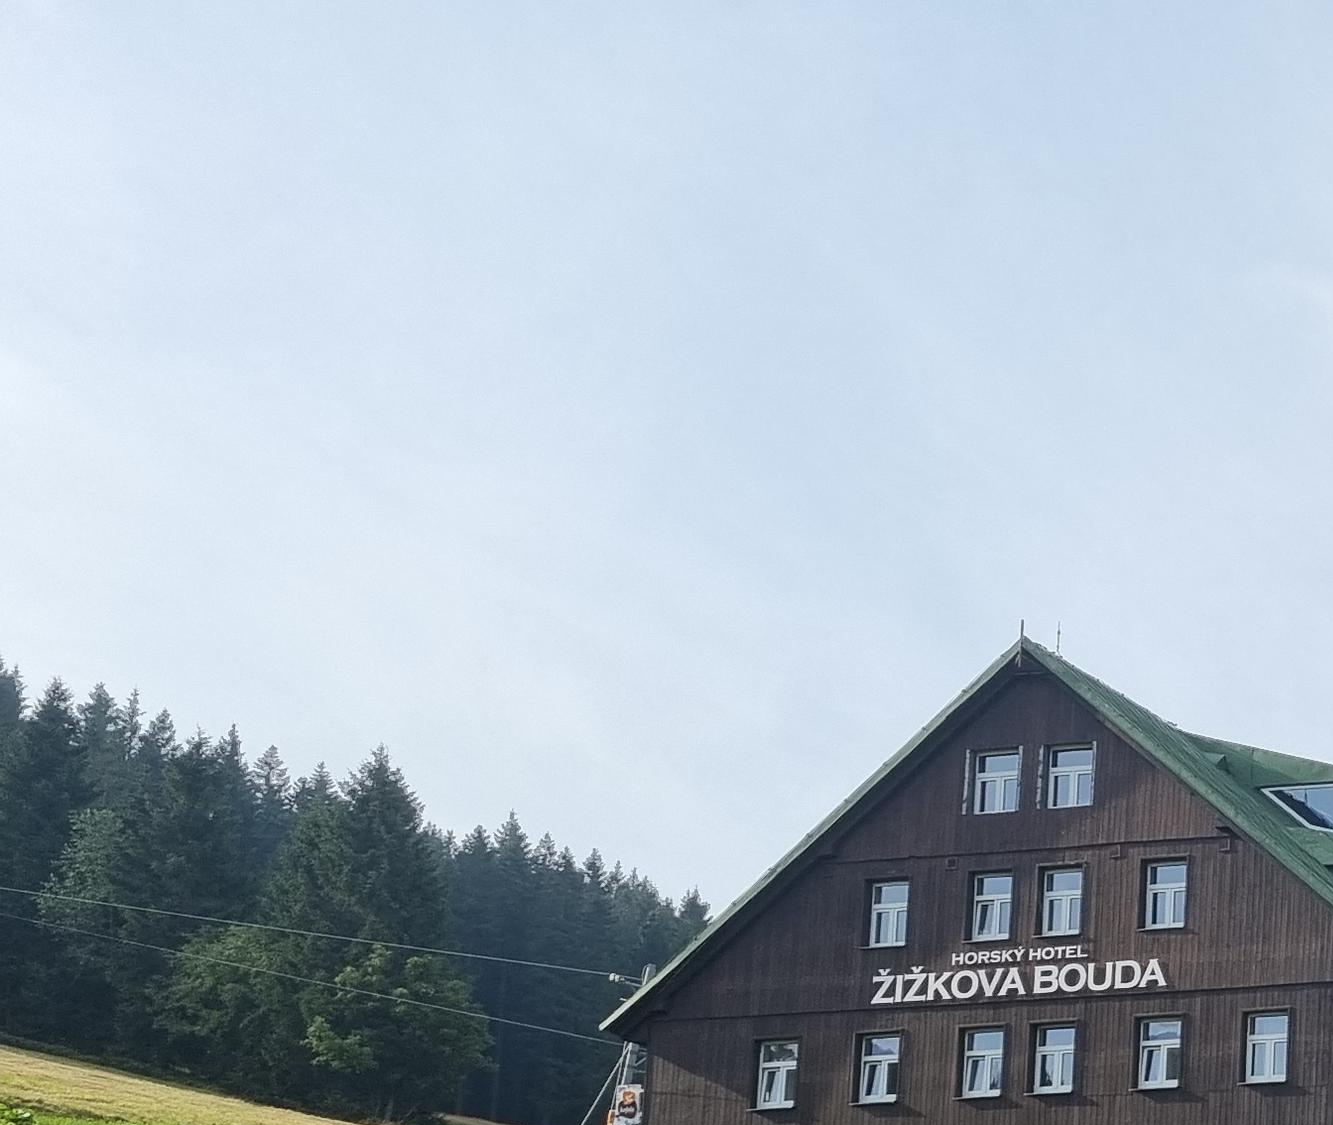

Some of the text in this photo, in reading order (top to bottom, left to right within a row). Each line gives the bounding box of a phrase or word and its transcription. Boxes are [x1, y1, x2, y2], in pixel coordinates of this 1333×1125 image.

[951, 945, 1088, 966] HORSKÝ HOTEL
[871, 958, 1168, 1005] ŽIŽKOVA BOUDA
